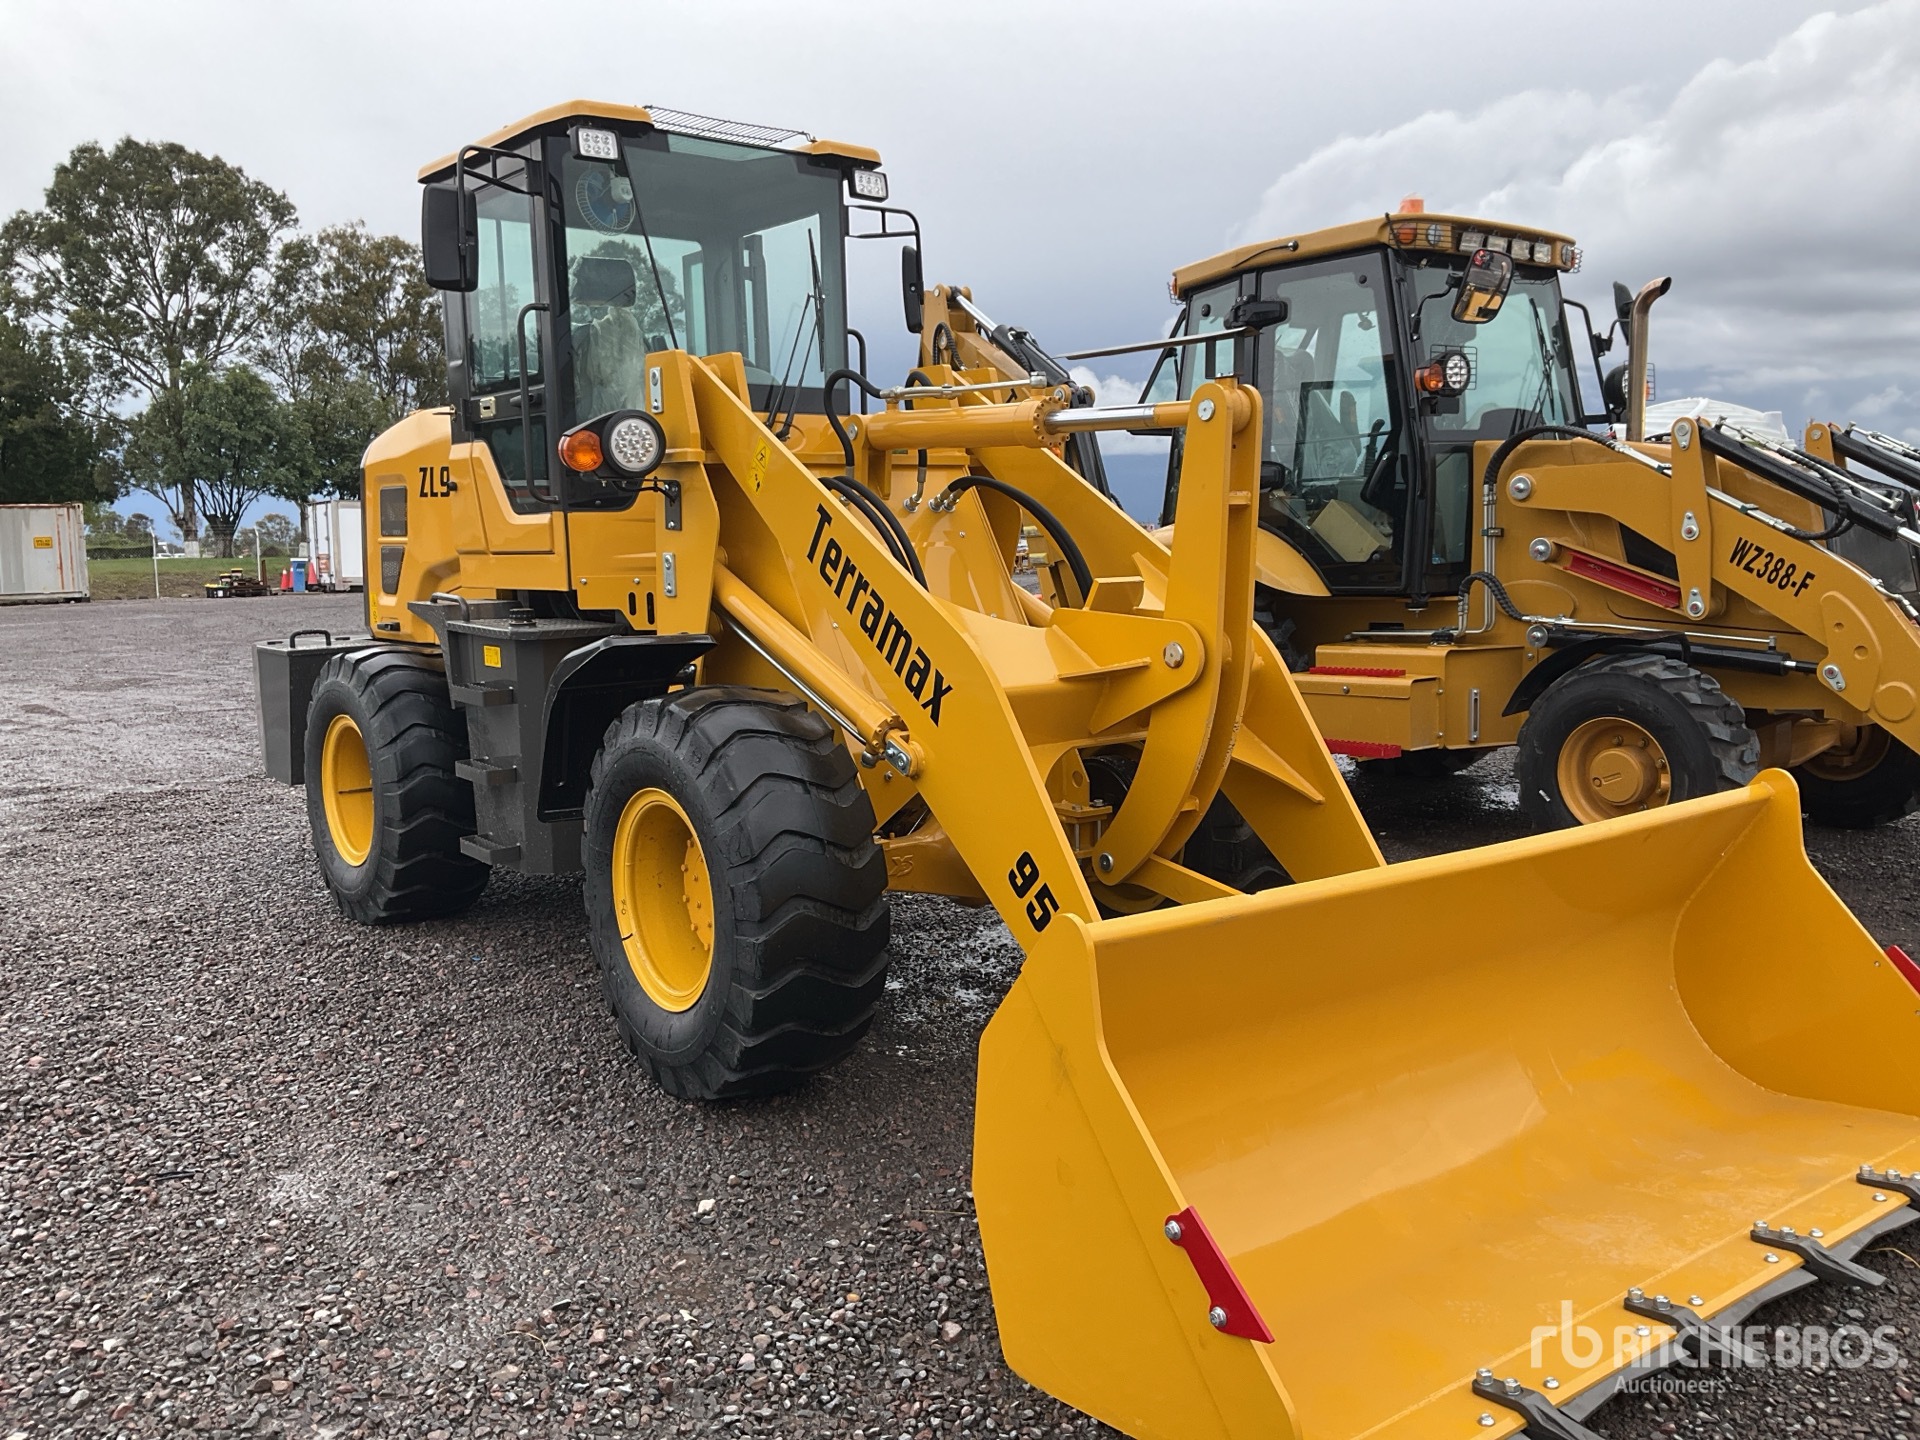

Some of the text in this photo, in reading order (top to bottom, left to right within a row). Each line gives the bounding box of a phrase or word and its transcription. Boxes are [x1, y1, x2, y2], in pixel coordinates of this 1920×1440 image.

[1729, 536, 1816, 598] WZ388-F
[806, 502, 954, 728] Terramax
[1008, 851, 1060, 933] 95
